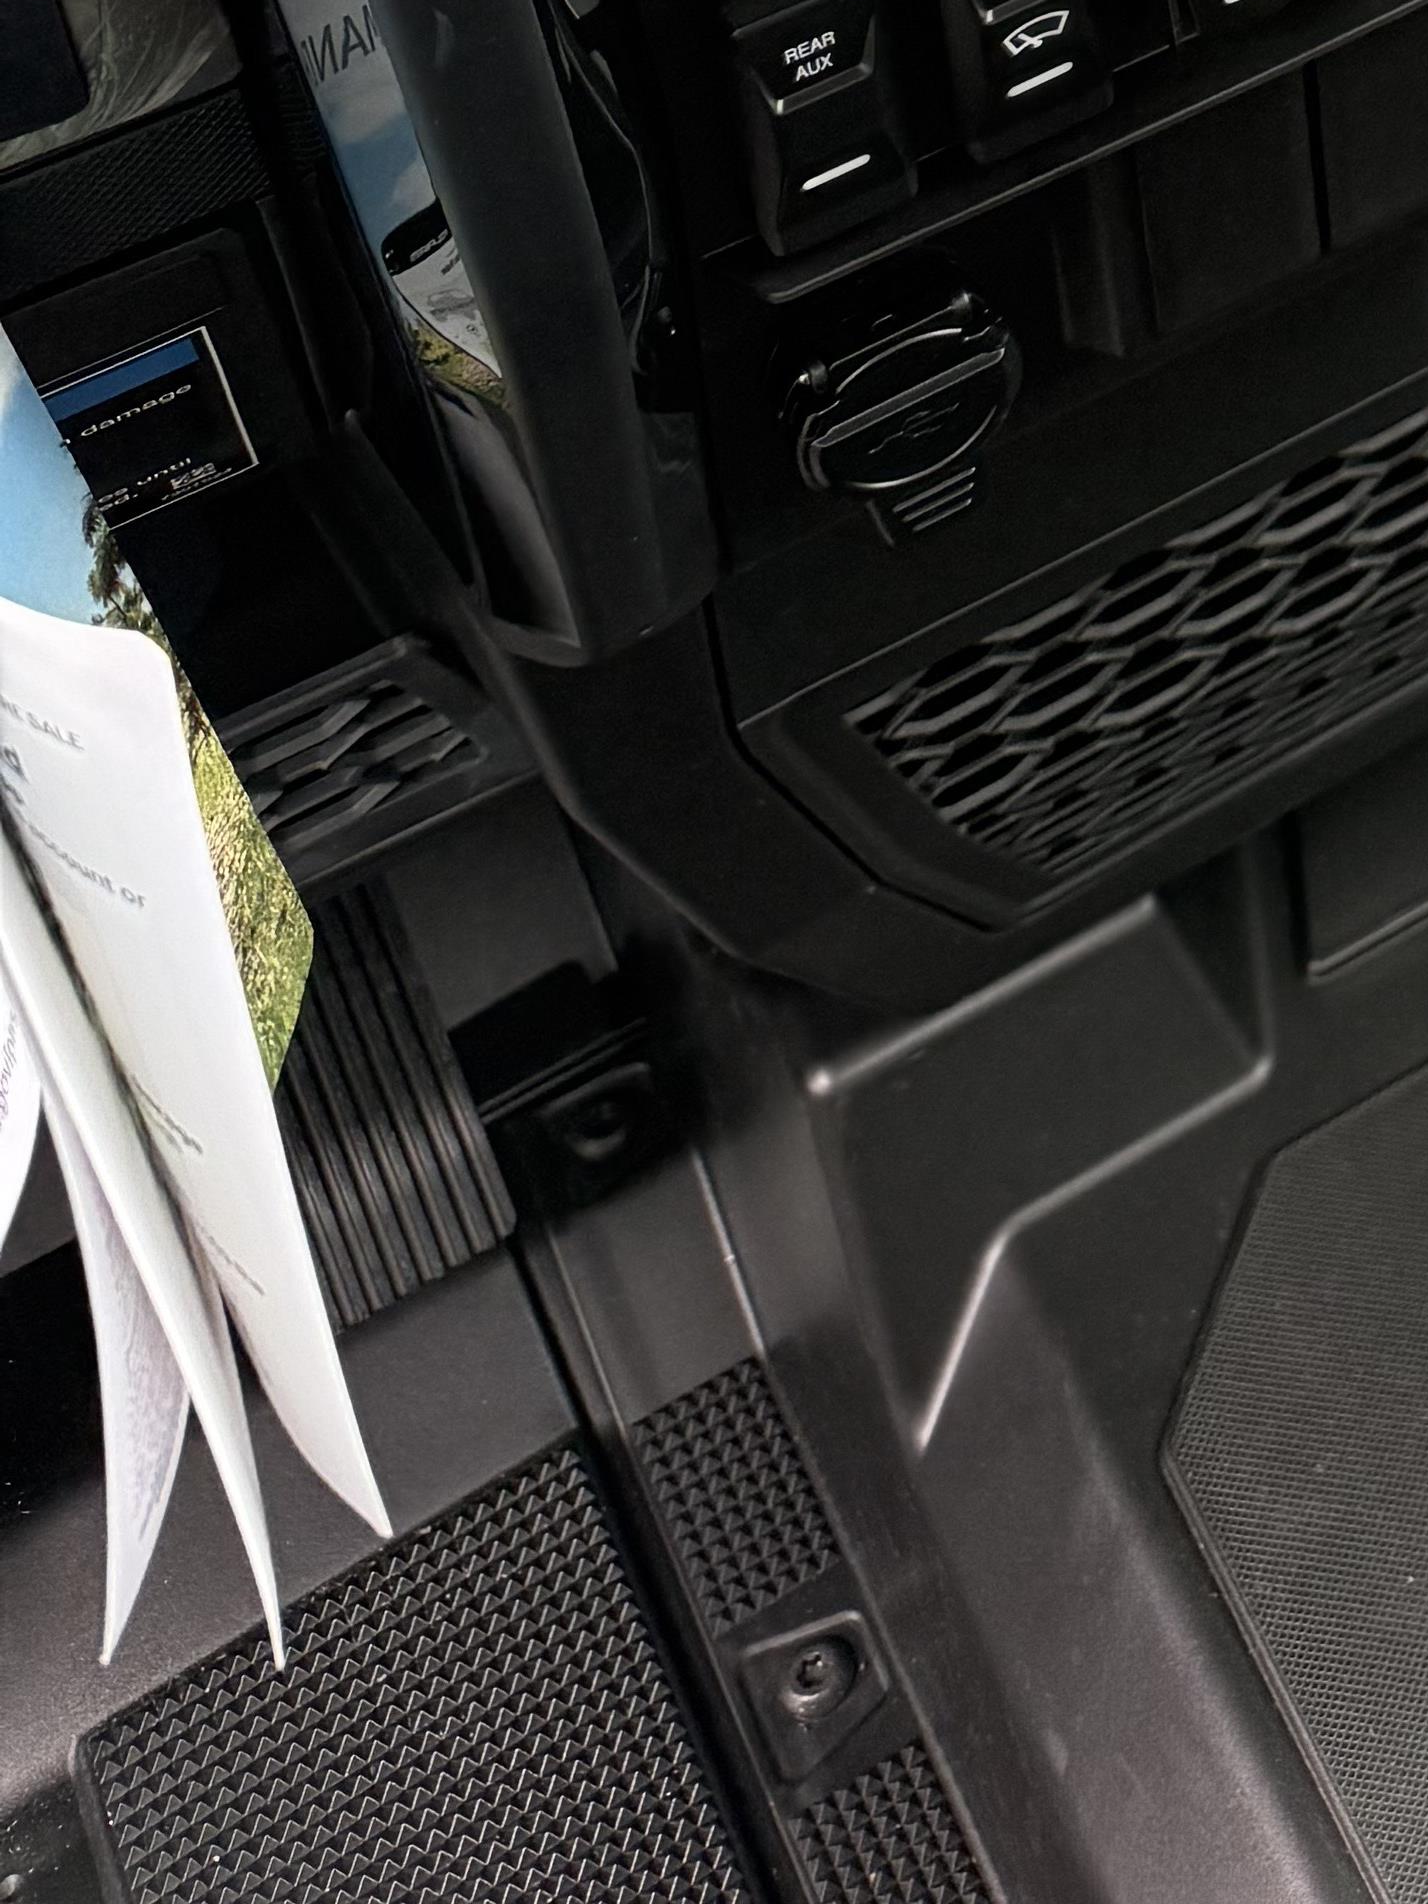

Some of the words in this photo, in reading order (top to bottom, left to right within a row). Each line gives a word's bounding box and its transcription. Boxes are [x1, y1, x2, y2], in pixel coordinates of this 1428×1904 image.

[784, 31, 836, 65] REAR
[795, 52, 834, 82] AUX
[80, 383, 192, 437] damage
